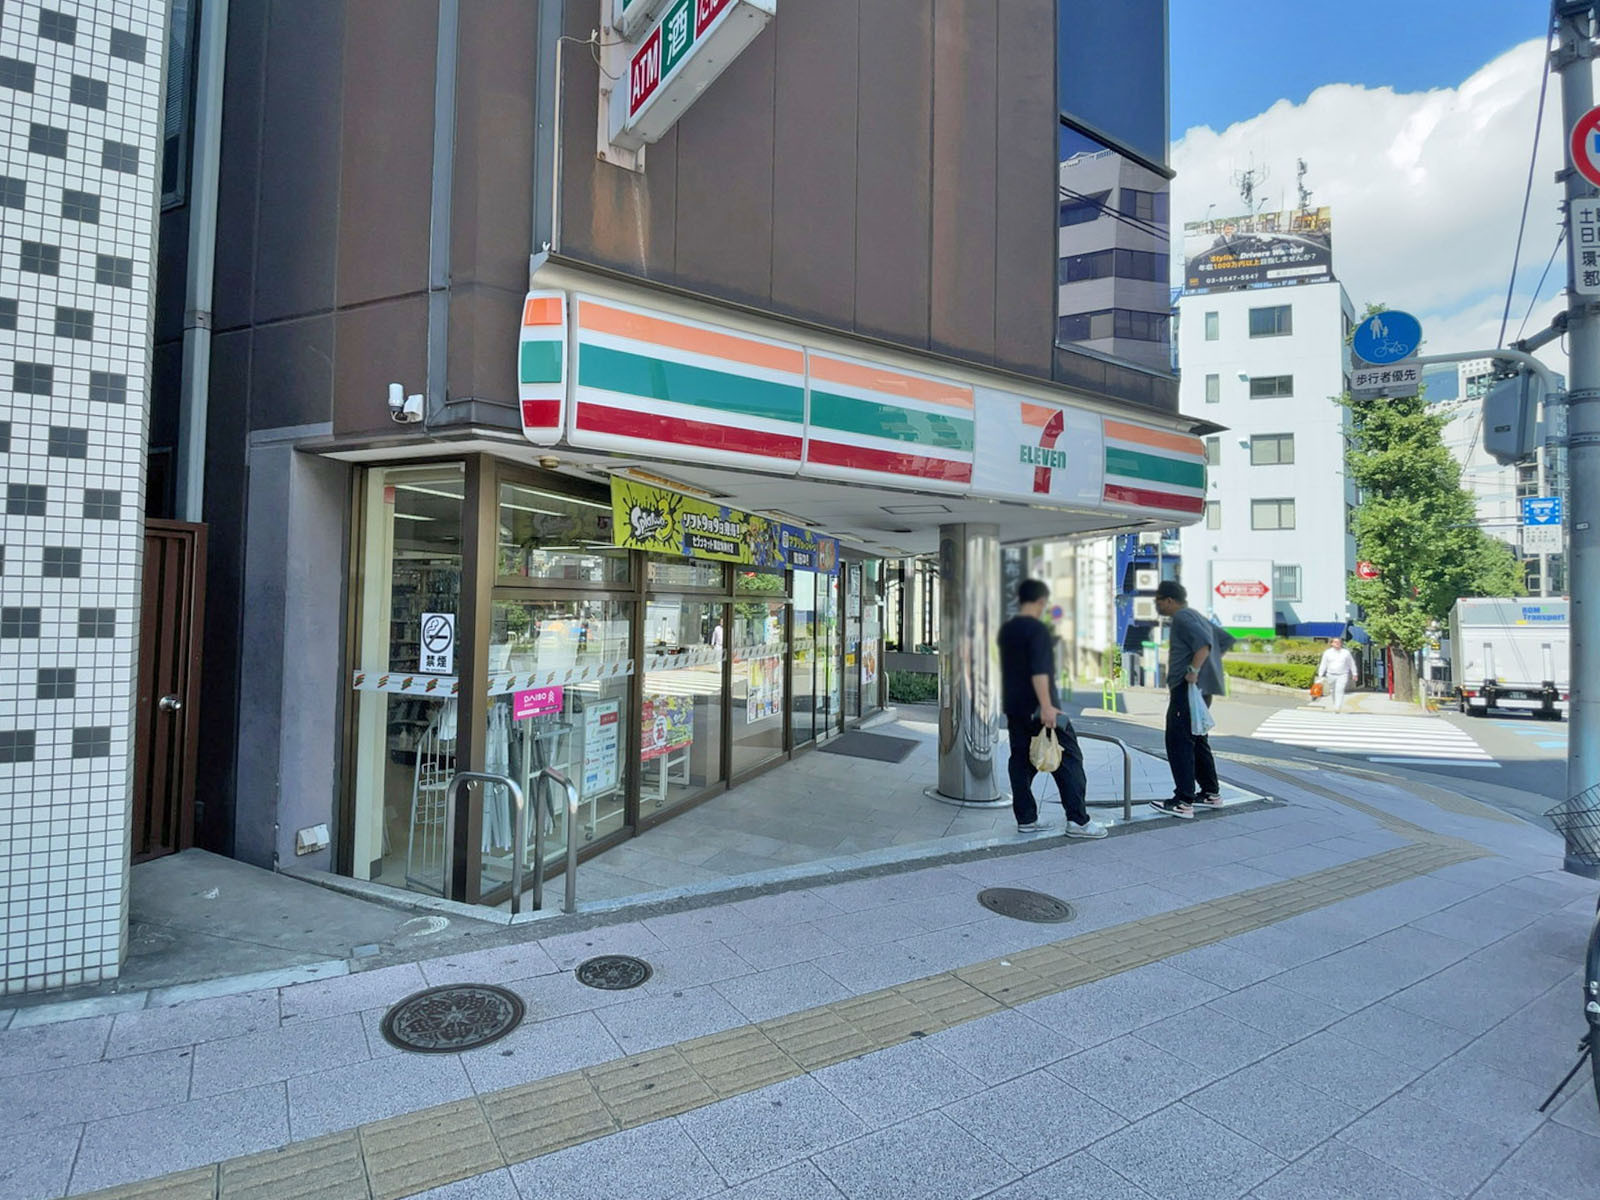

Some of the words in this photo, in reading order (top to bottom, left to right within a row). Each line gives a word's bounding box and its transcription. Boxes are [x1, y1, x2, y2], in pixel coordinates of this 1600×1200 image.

[667, 1, 689, 66] 酒
[632, 39, 659, 106] ATM
[1579, 207, 1600, 224] 土
[1581, 227, 1600, 243] 日
[1582, 251, 1600, 267] 環
[1355, 369, 1417, 387] 歩行者優先
[426, 655, 447, 668] 禁煙
